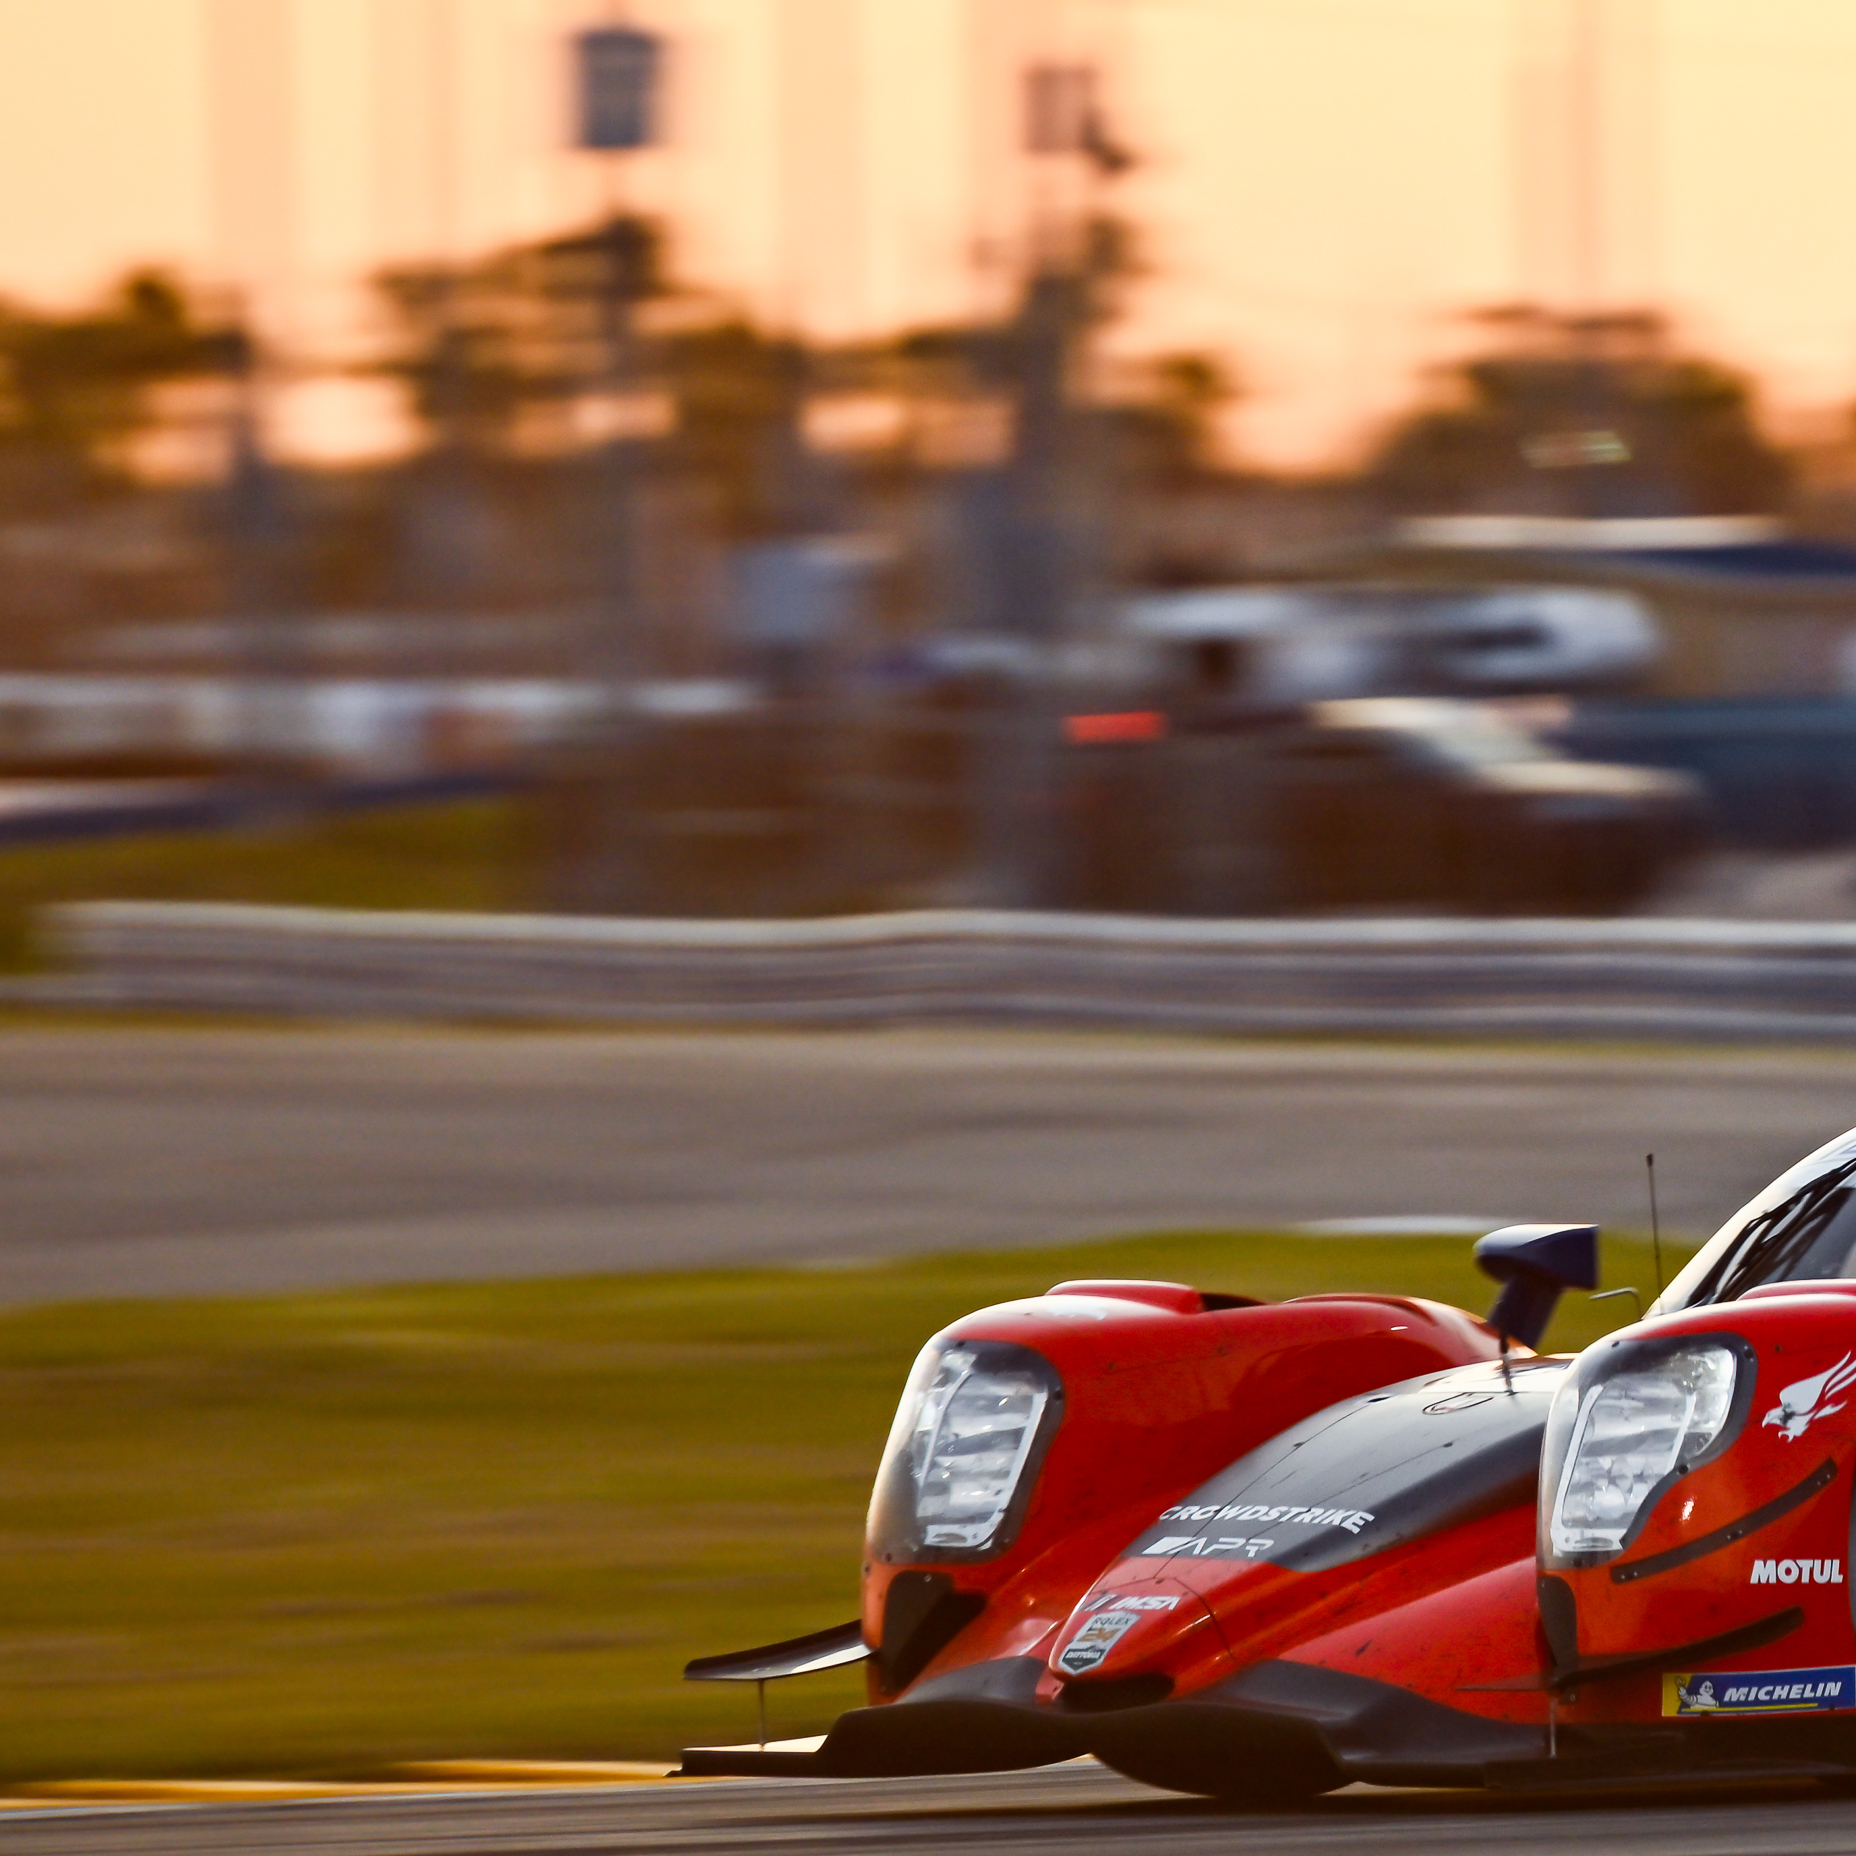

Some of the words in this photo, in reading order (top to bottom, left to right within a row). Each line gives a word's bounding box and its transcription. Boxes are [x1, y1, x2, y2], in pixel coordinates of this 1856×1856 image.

[1159, 1505, 1375, 1534] CROWDSTRIKE
[1750, 1559, 1844, 1584] MOTUL
[1108, 1596, 1180, 1610] IMSA
[1091, 1616, 1131, 1625] ROLEX
[1065, 1650, 1102, 1659] DAYTONA
[1723, 1681, 1843, 1702] MICHELIN
